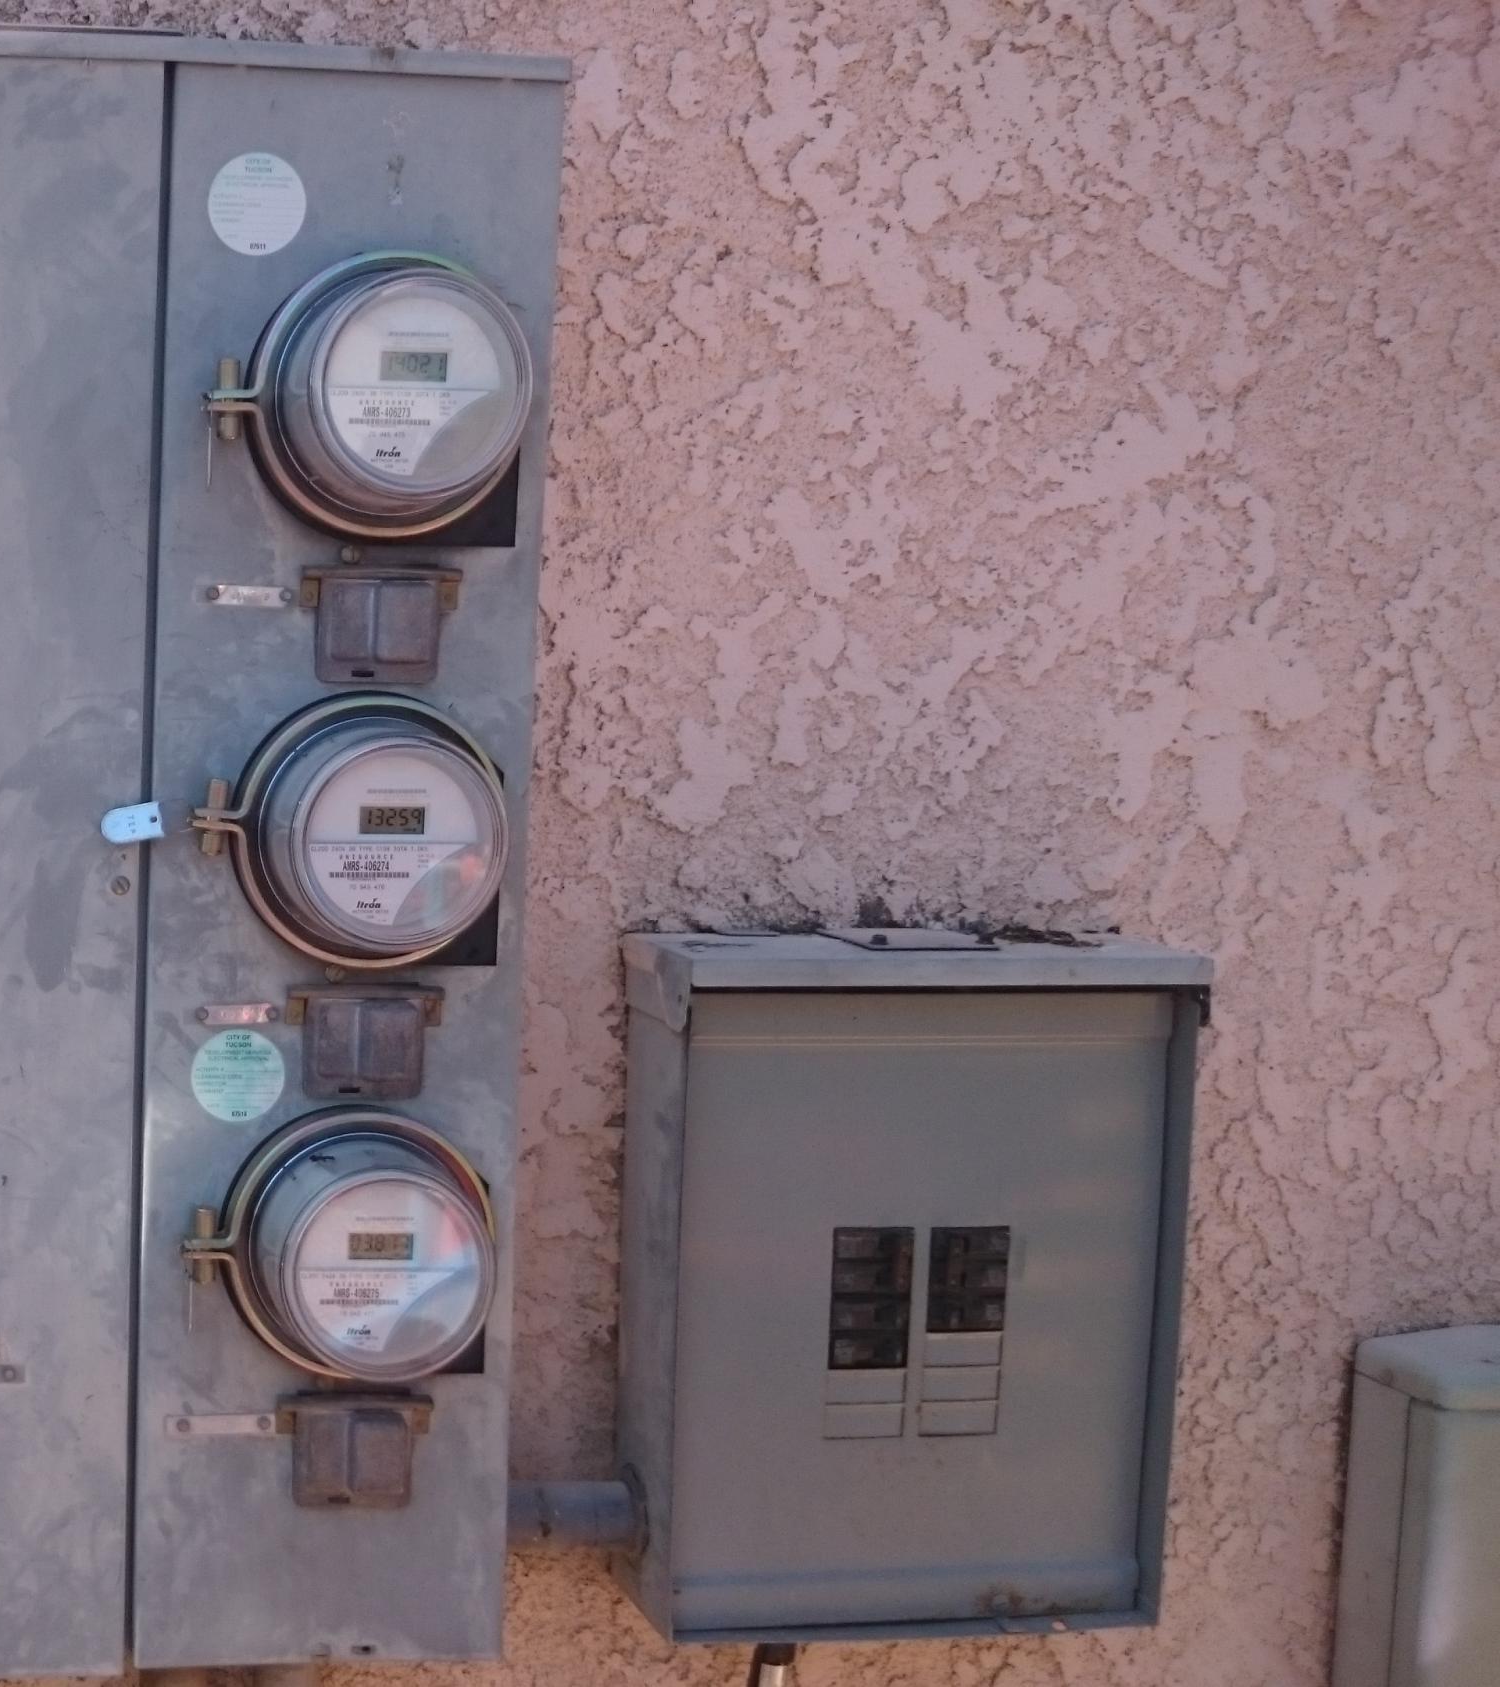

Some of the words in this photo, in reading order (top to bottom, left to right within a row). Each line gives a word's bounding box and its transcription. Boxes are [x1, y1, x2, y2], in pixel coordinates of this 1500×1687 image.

[375, 446, 401, 457] Itron
[367, 807, 422, 827] 13259
[342, 860, 390, 871] AMRS-406274
[356, 897, 382, 909] Itron
[346, 1324, 372, 1335] Itron
